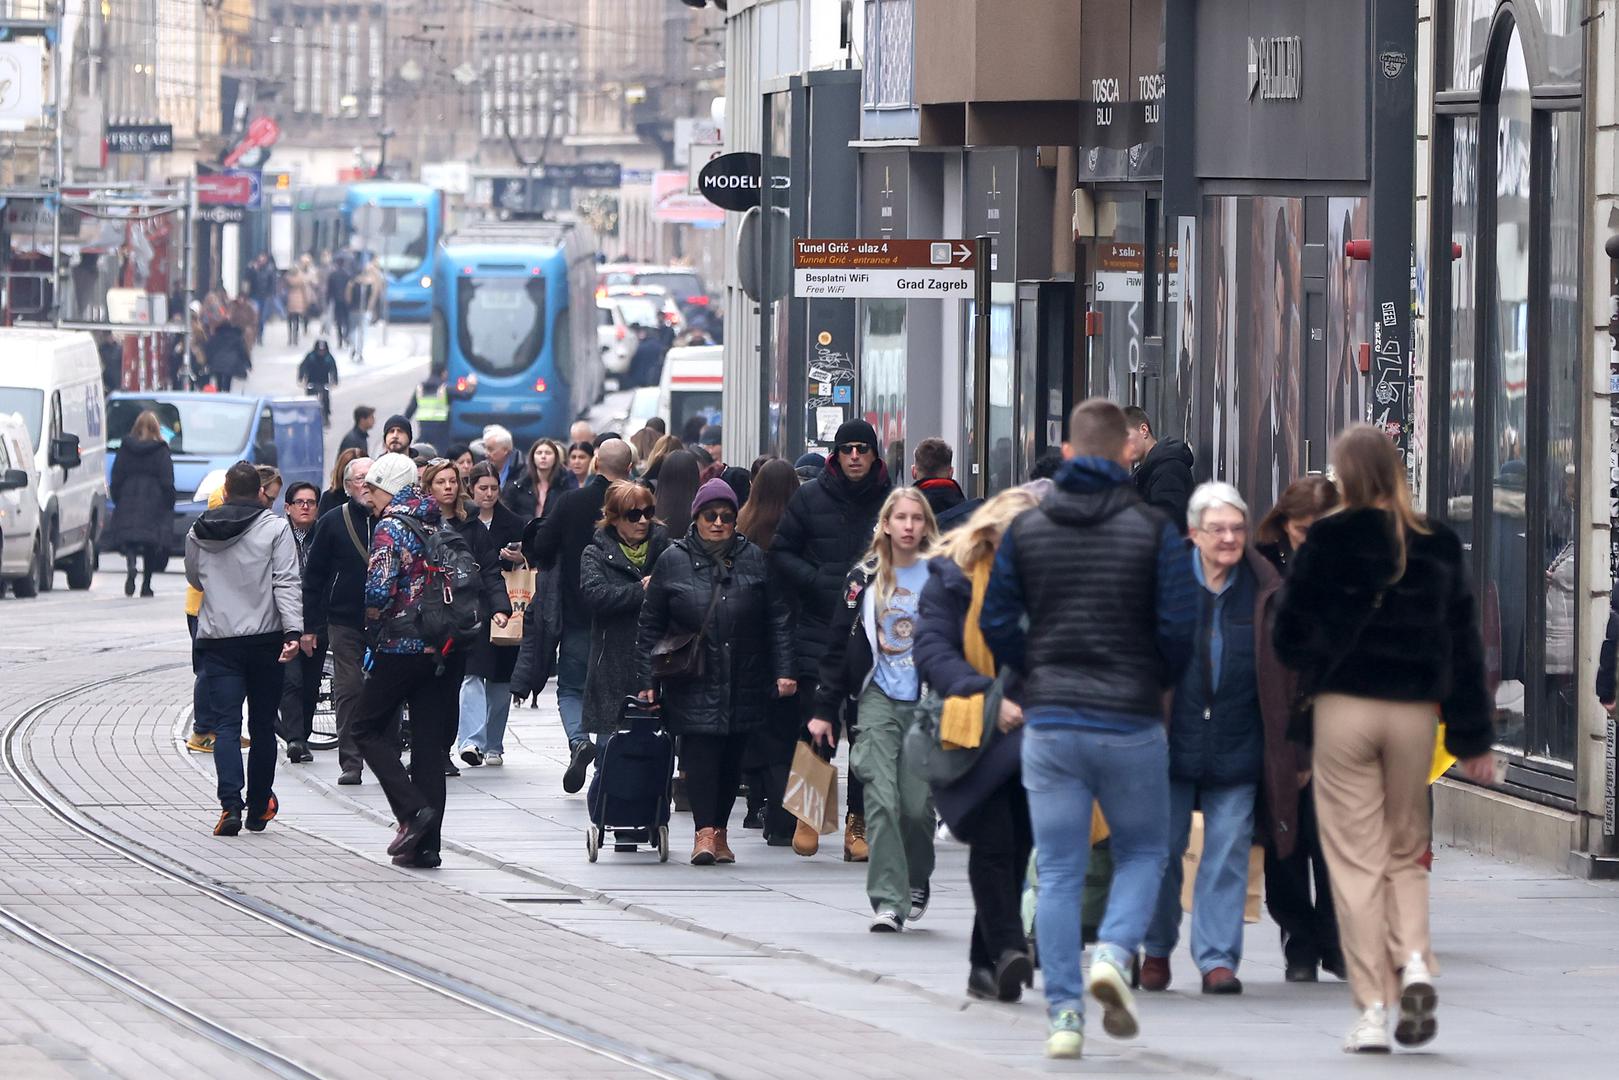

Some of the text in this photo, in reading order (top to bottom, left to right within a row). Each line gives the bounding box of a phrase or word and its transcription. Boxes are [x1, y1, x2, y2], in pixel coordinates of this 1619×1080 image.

[1092, 78, 1120, 103] TOSCA
[1139, 73, 1166, 101] TOSCA
[1096, 107, 1112, 126] BLU
[1144, 104, 1159, 123] BLU
[798, 243, 826, 253] Tunel
[828, 242, 849, 253] Grič
[858, 243, 879, 253] ulaz
[881, 243, 888, 253] 4
[799, 256, 828, 264] Tunnel
[853, 256, 891, 264] entrance
[892, 256, 898, 264] 4
[805, 273, 869, 283] Besplatni WiFi
[896, 279, 968, 291] Grad Zagreb
[805, 285, 845, 294] Free WiFi
[1383, 304, 1396, 325] SIFEN
